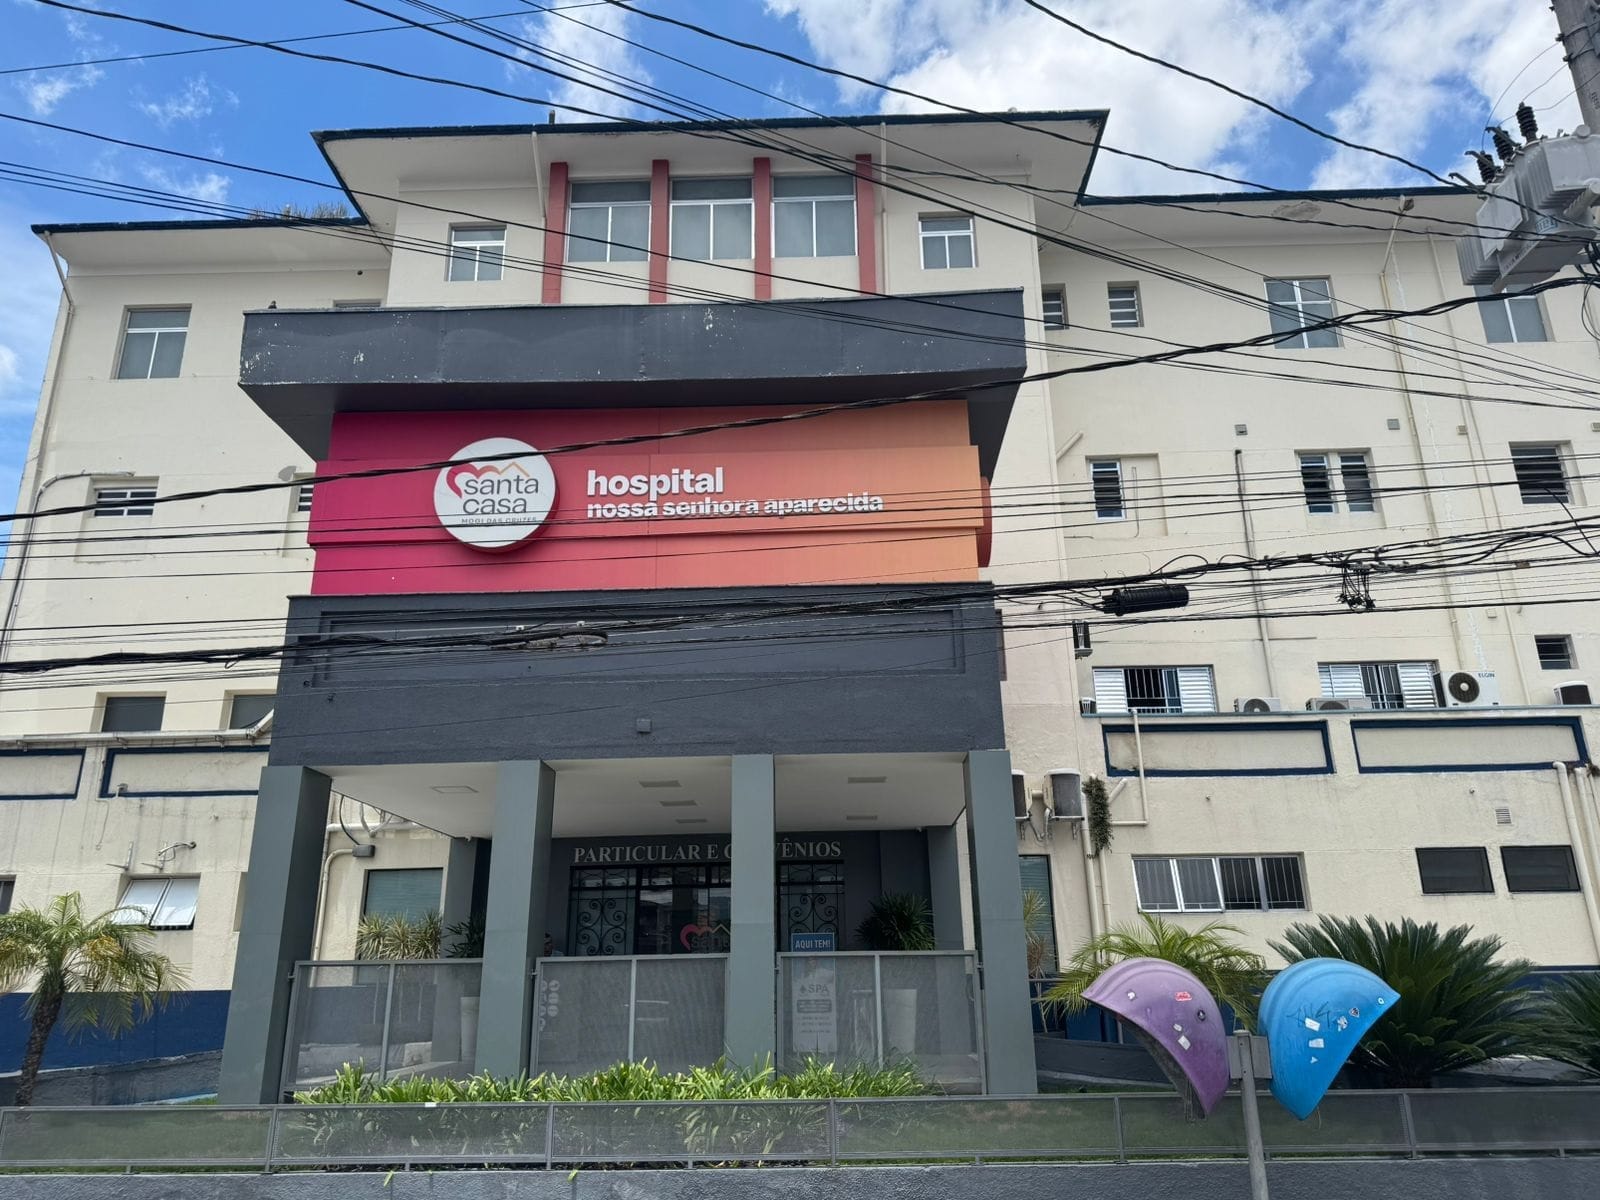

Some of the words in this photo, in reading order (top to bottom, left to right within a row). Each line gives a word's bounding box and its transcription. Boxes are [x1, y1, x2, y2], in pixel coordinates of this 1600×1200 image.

[463, 474, 540, 496] santa
[587, 466, 724, 502] hospital
[462, 497, 528, 515] casa
[586, 501, 659, 519] nossa
[662, 496, 759, 516] senhora
[763, 491, 884, 516] aparecida
[573, 844, 702, 864] PARTICULAR
[706, 844, 719, 860] E
[795, 939, 813, 949] AQUI
[814, 939, 831, 948] TEM!
[807, 983, 830, 994] SPA
